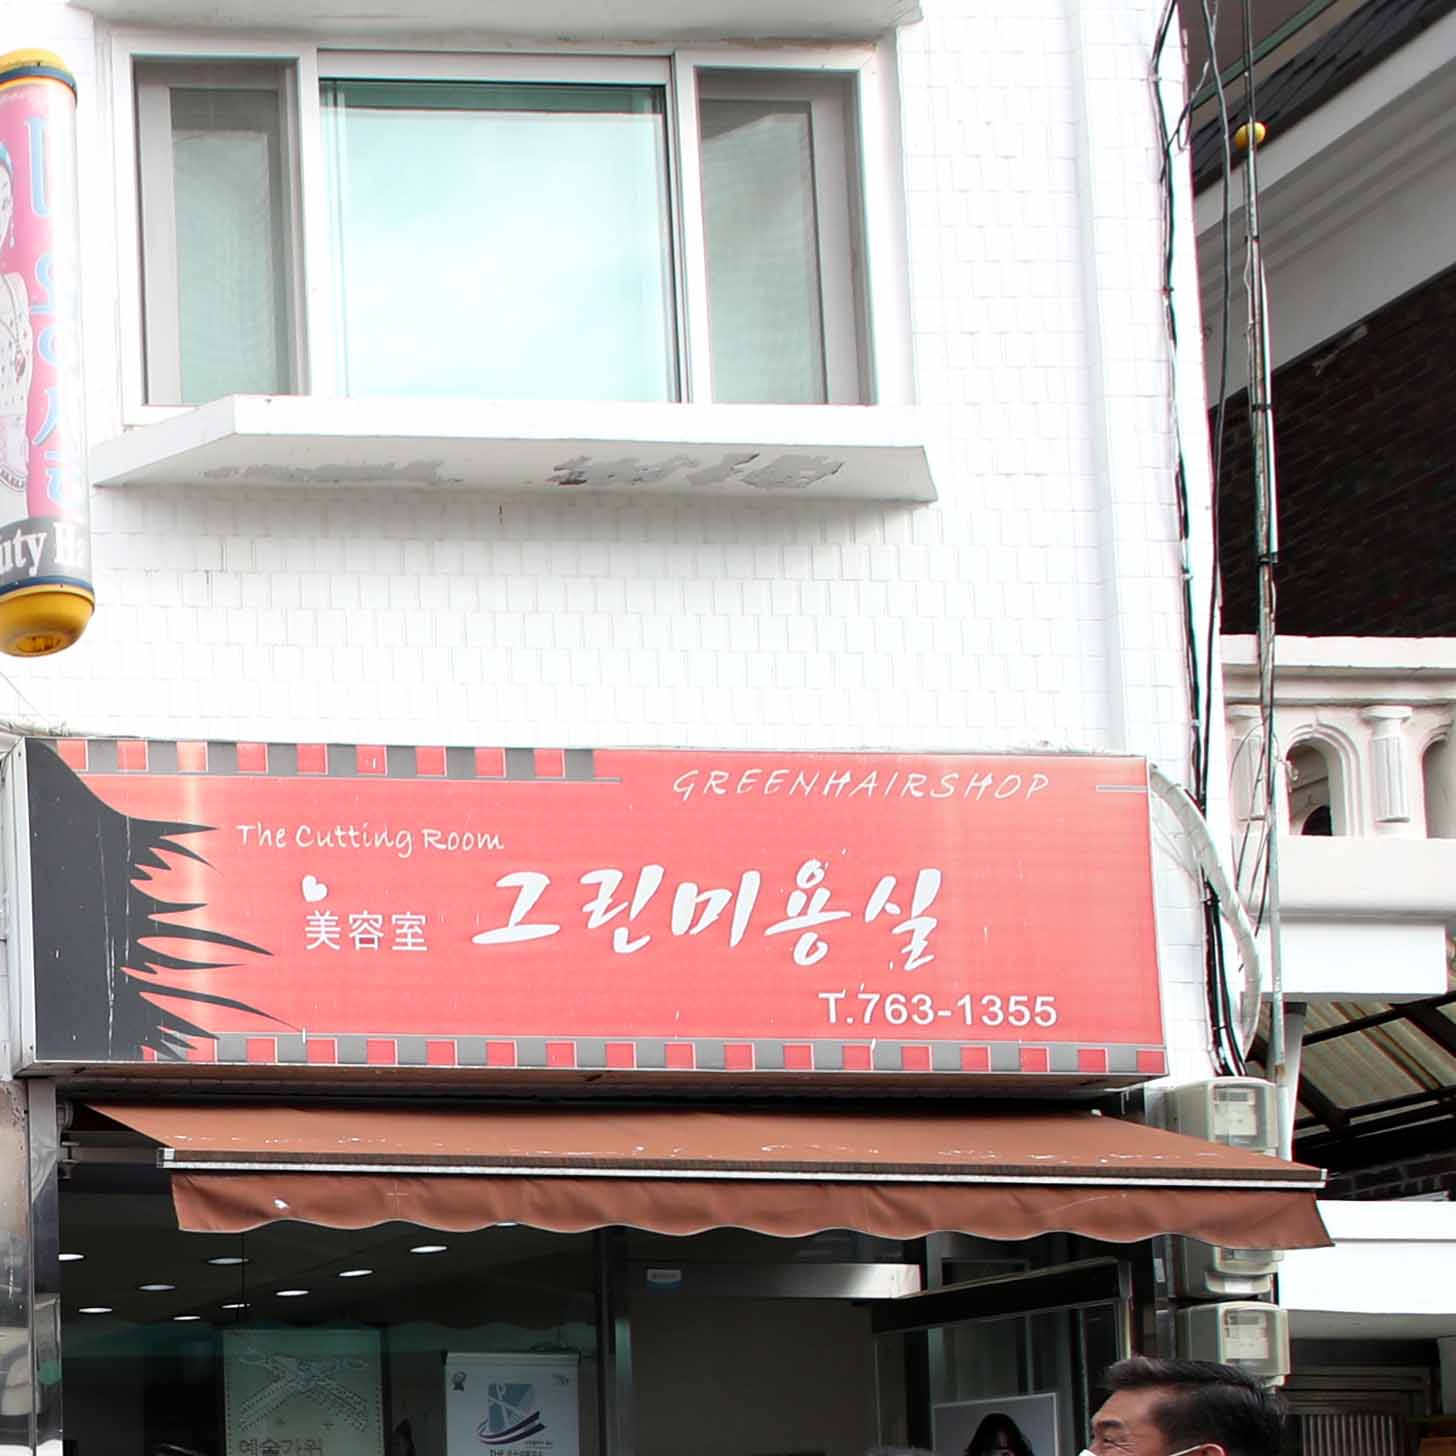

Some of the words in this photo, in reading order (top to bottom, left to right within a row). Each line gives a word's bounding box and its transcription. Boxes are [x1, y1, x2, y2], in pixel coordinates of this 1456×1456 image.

[236, 822, 286, 848] The
[295, 822, 413, 858] Cutting
[422, 830, 506, 852] Room
[304, 910, 429, 953] 美容室
[472, 860, 942, 972] 그린미용실
[818, 993, 1058, 1028] T.763-1355
